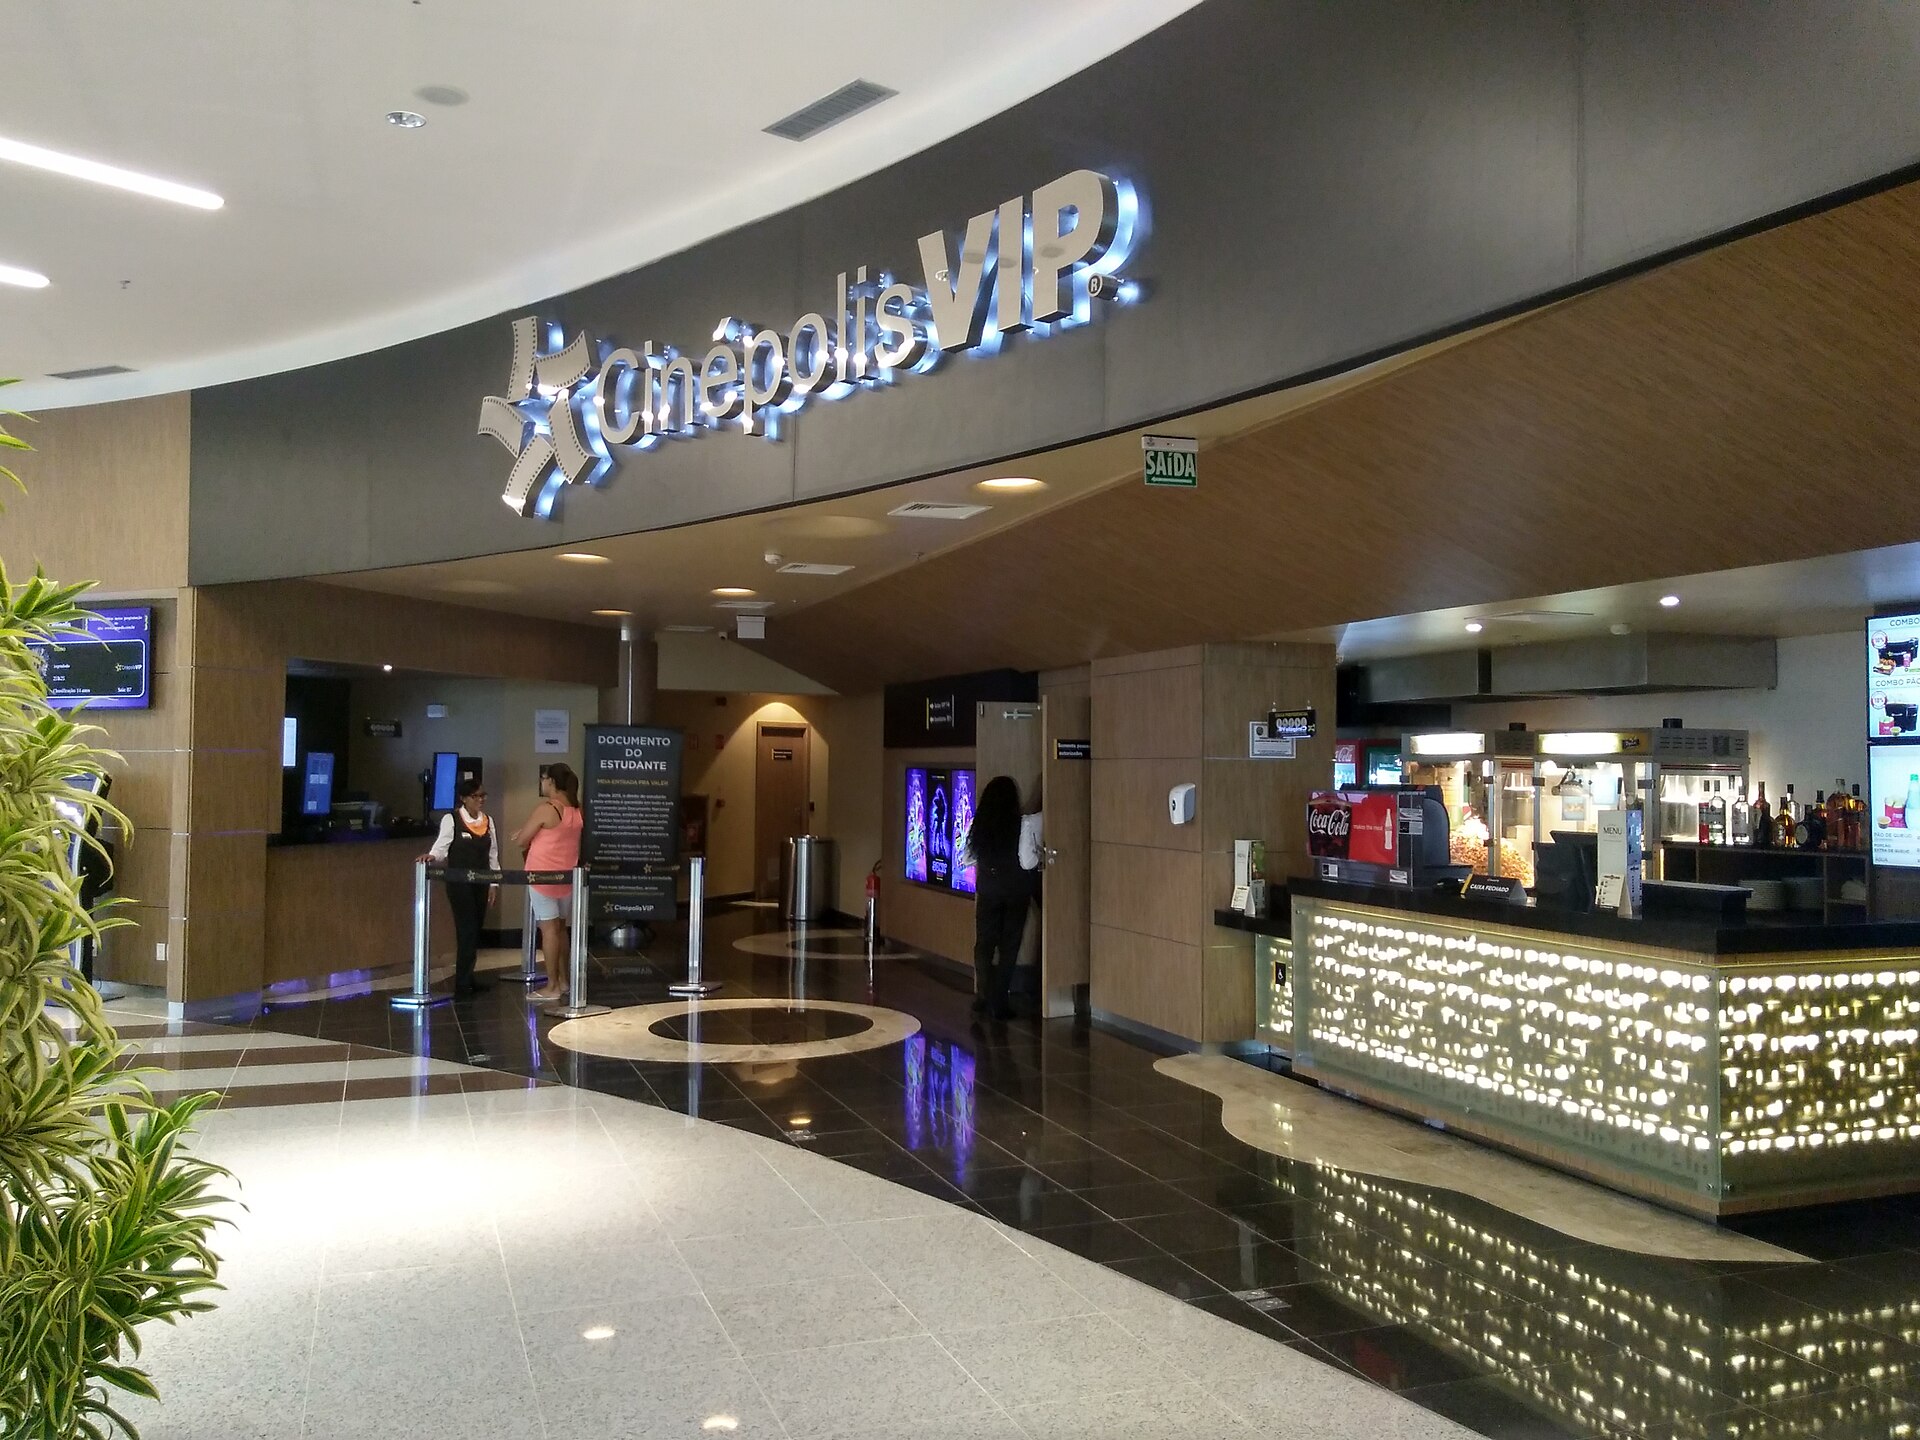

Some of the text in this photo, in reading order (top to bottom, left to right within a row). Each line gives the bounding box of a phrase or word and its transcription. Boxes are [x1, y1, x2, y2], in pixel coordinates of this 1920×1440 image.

[1146, 450, 1196, 477] SAÍDA
[598, 735, 671, 746] DOCUMENTO
[625, 748, 643, 757] DO
[600, 759, 667, 771] ESTUDANTE
[1310, 808, 1351, 836] Coca-Cola
